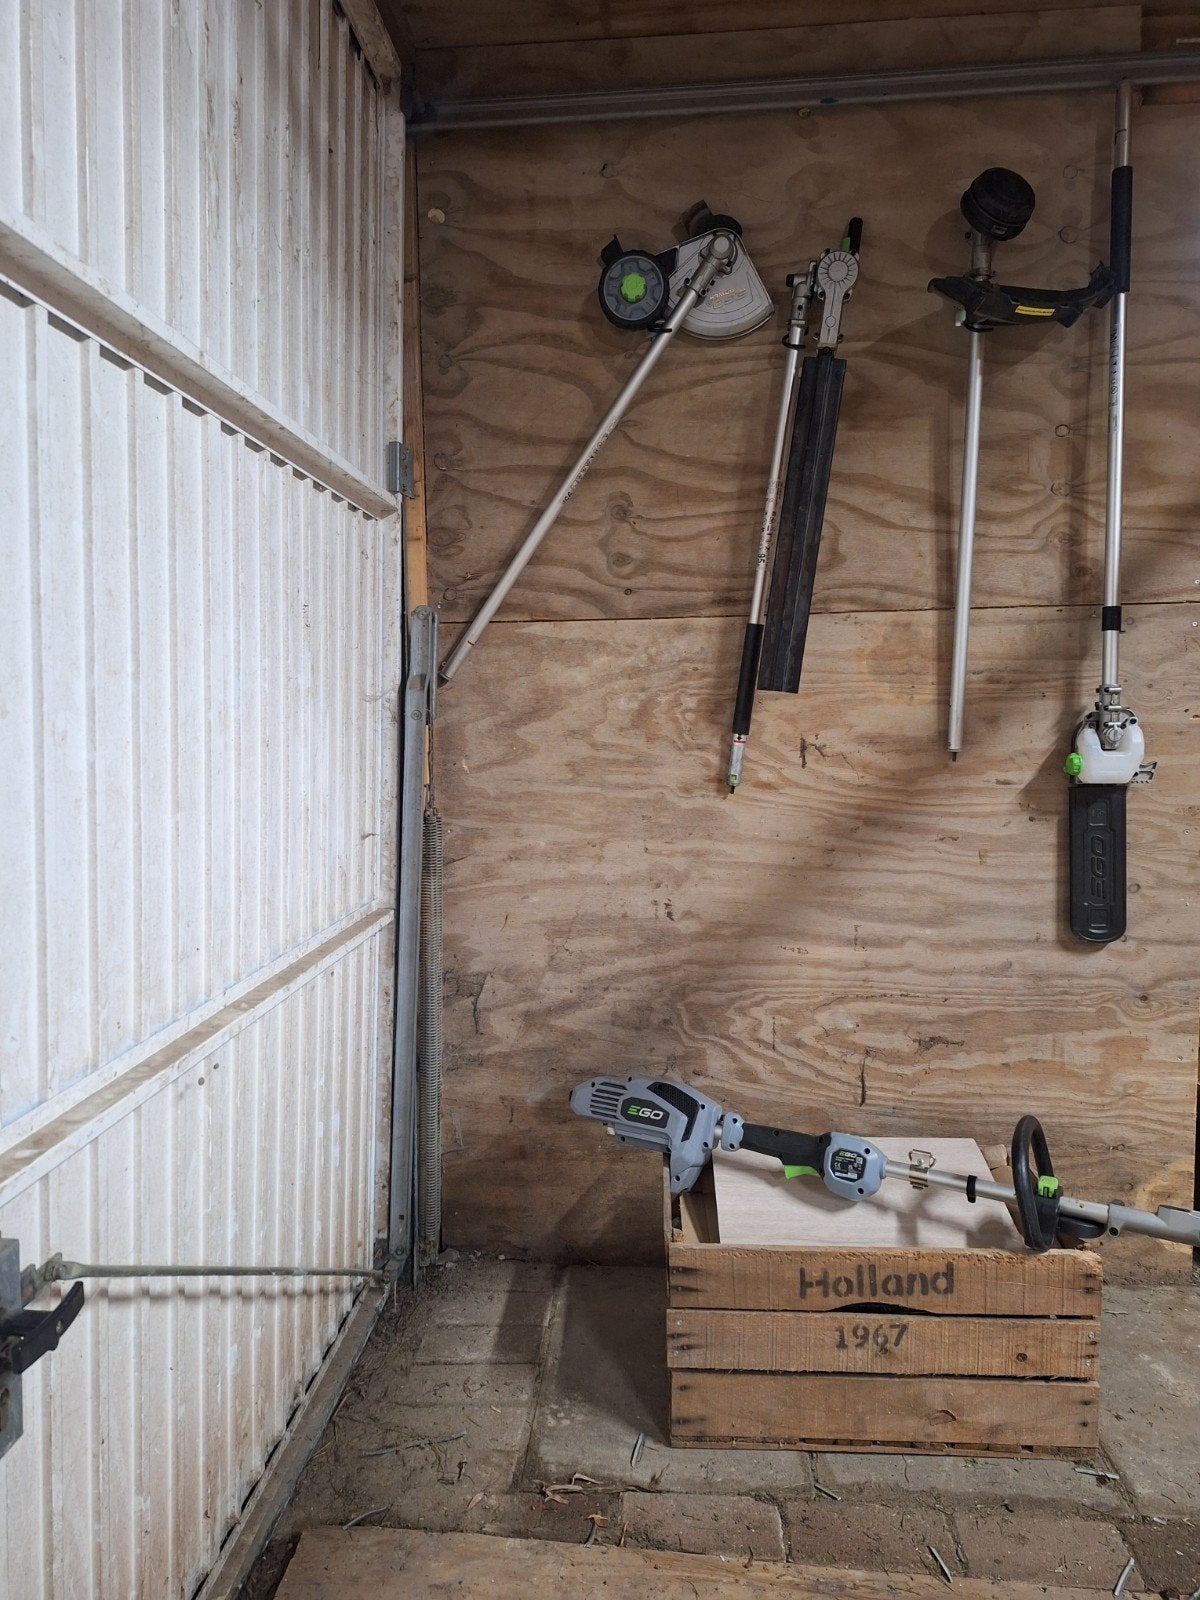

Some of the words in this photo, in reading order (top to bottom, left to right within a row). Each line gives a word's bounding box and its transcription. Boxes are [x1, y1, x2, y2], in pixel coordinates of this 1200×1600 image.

[1090, 834, 1105, 899] EGO
[627, 1105, 664, 1120] EGO
[799, 1261, 954, 1299] Holland
[836, 1323, 908, 1350] 1967
